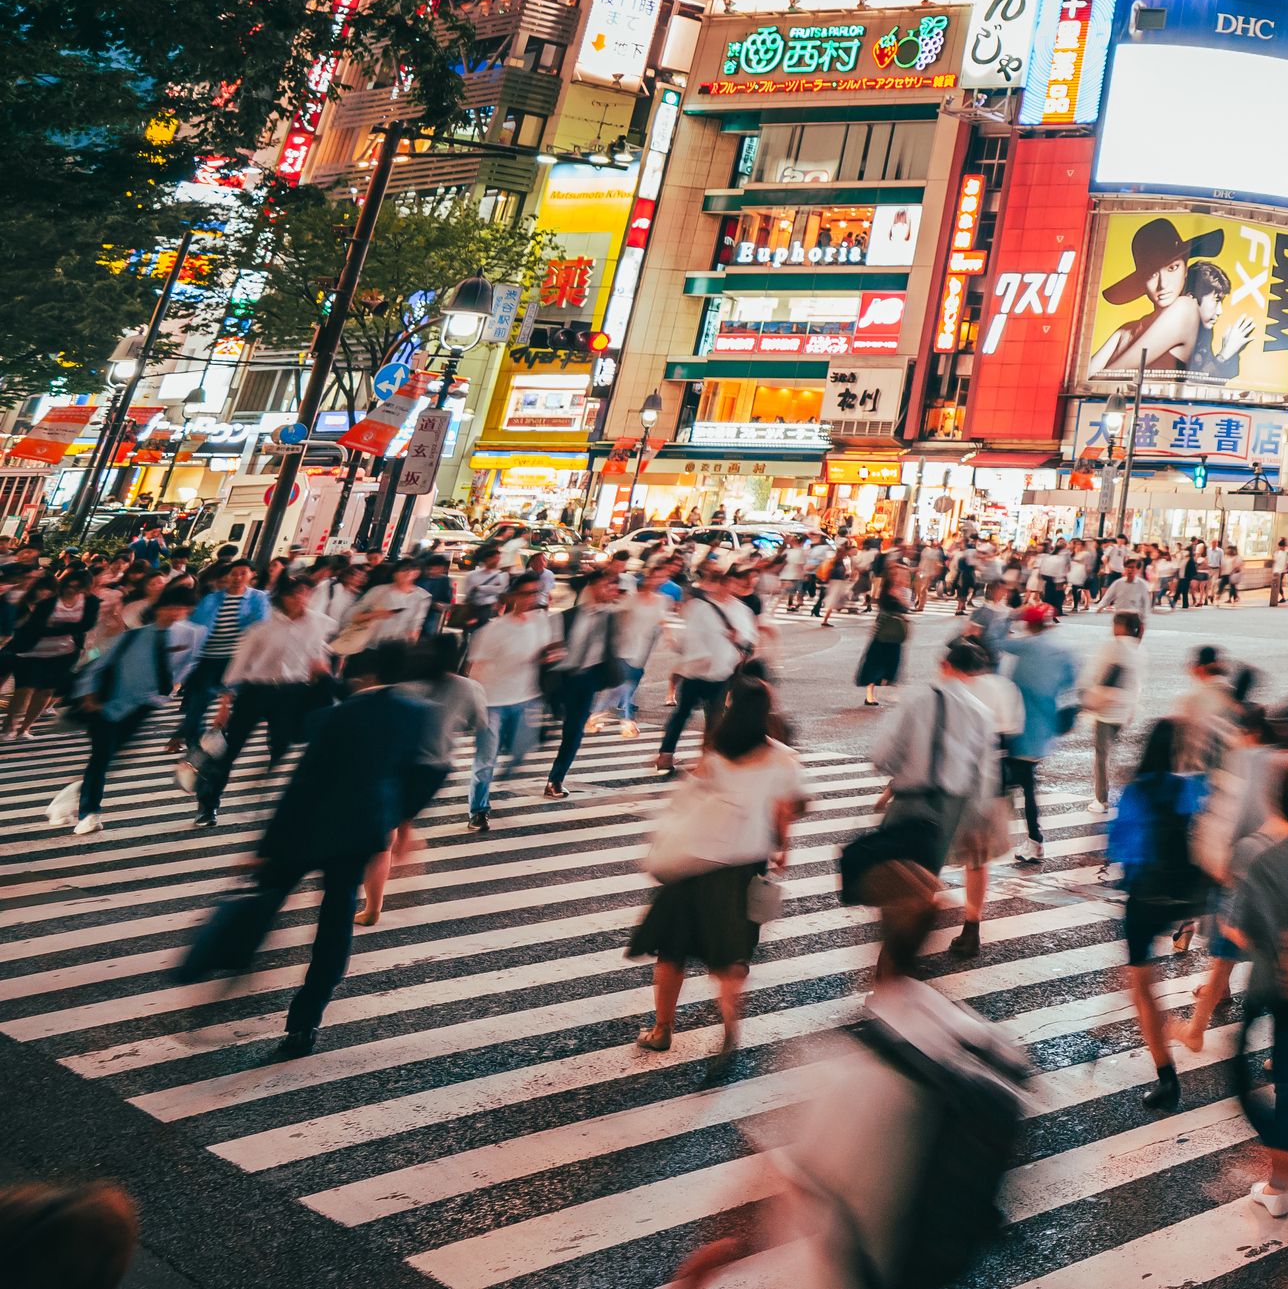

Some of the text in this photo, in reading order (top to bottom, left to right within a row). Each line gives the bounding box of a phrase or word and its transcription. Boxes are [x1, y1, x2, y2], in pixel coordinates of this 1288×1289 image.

[1215, 12, 1275, 40] DHC
[783, 39, 861, 74] 西村
[550, 190, 604, 200] Matsumoto
[1213, 189, 1237, 200] DHC
[737, 241, 866, 268] Euphoria
[1230, 225, 1271, 310] FX
[402, 417, 437, 486] 道玄坂
